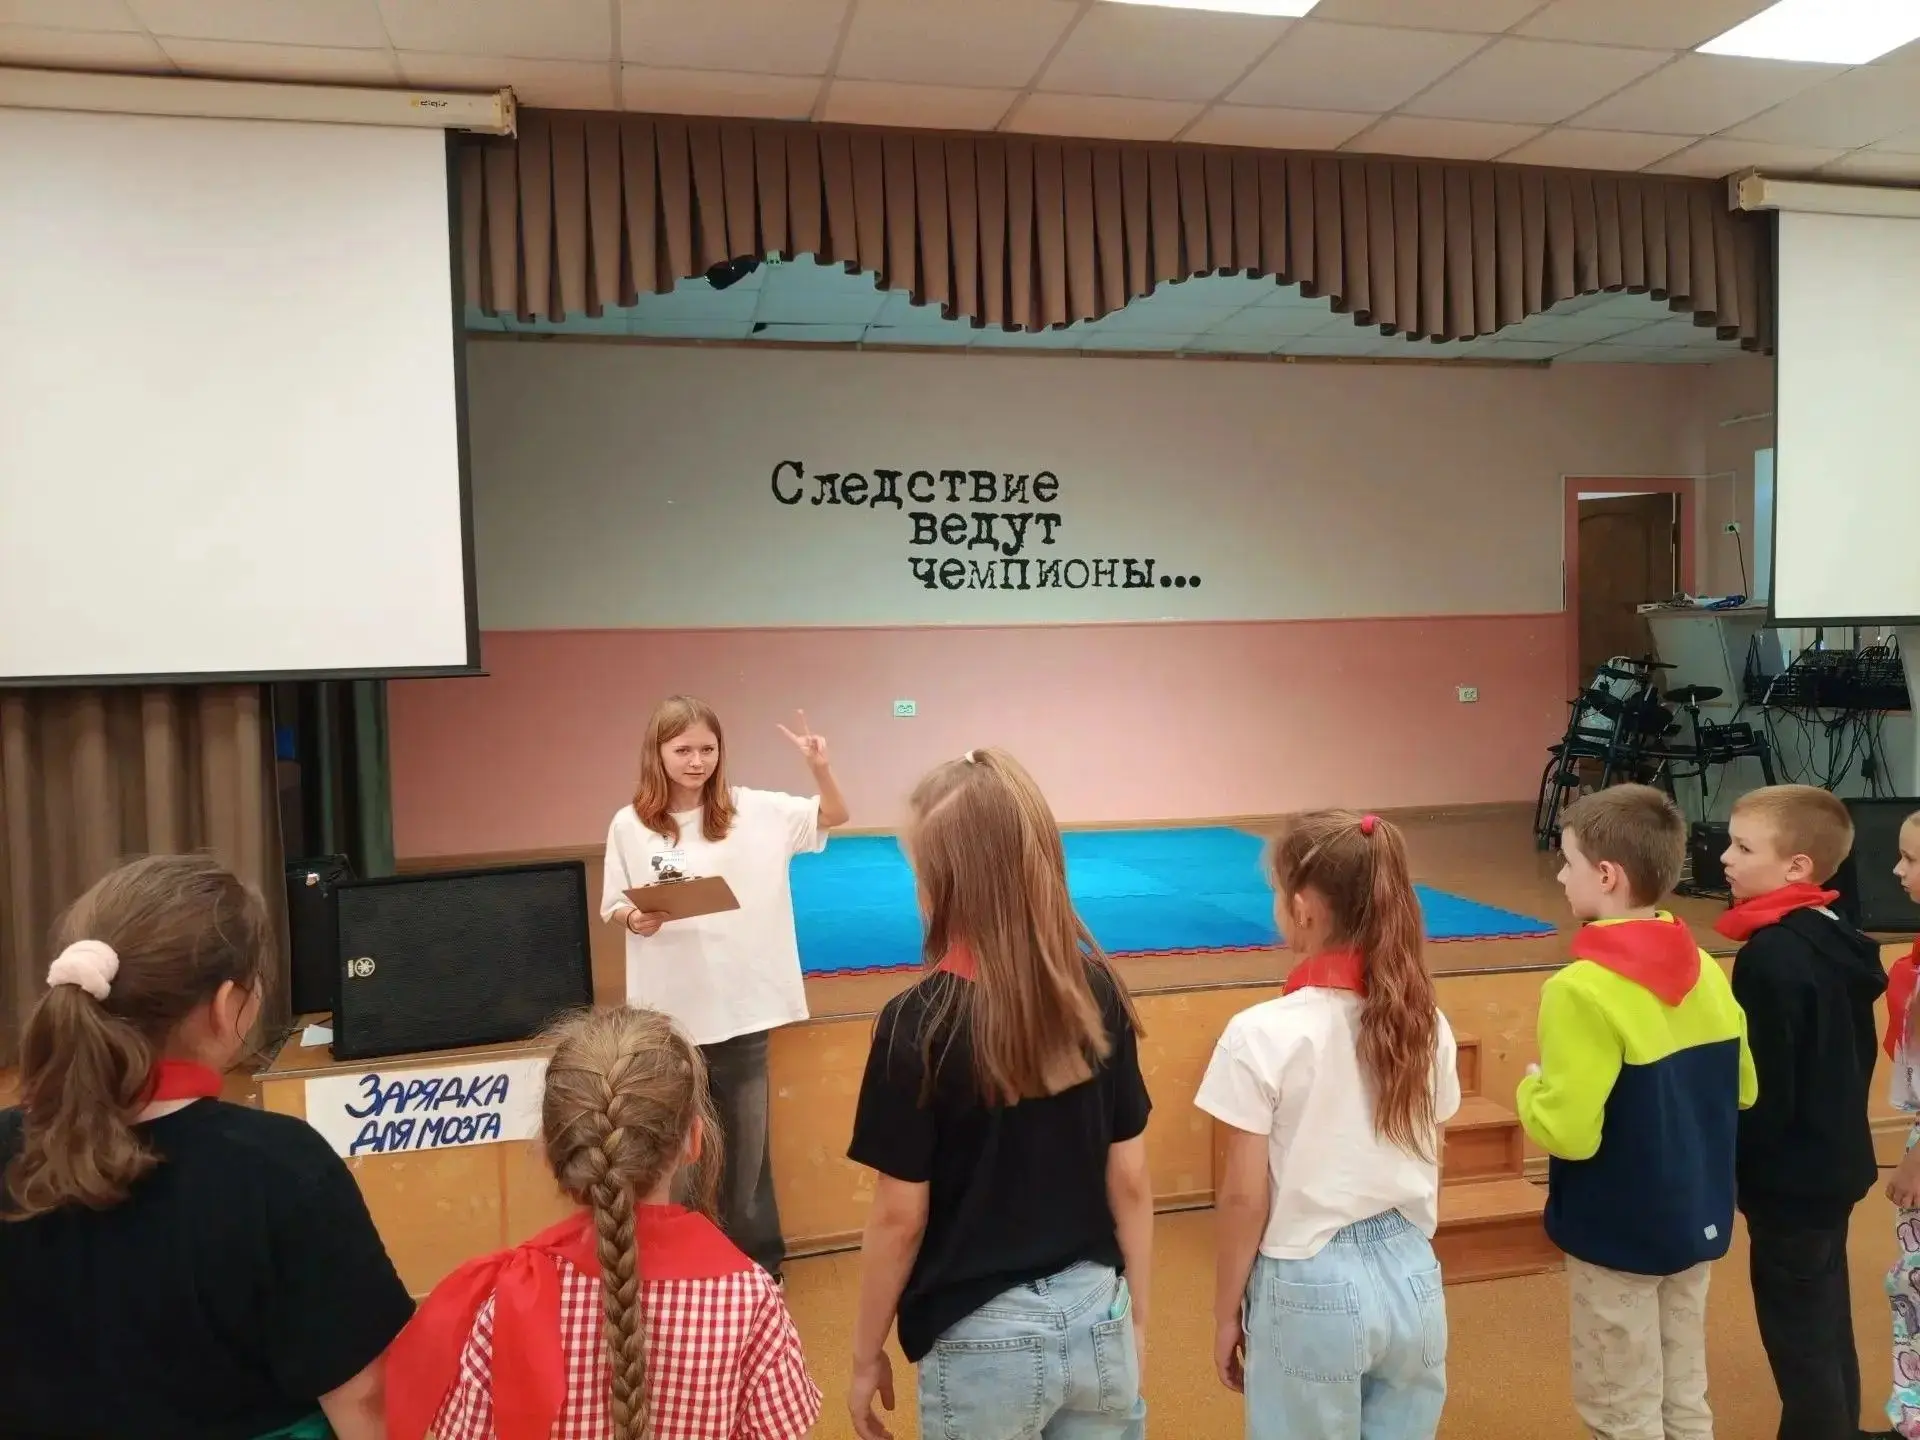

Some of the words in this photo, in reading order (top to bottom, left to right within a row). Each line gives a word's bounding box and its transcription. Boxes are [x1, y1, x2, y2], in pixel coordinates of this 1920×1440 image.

[771, 460, 1061, 510] Следствие
[907, 511, 1062, 556] ведут
[907, 557, 1203, 590] чемпионы...
[344, 1073, 510, 1119] ЗАРЯДКА
[350, 1117, 417, 1156] ДЛЯ
[415, 1112, 501, 1149] МОЗГА
